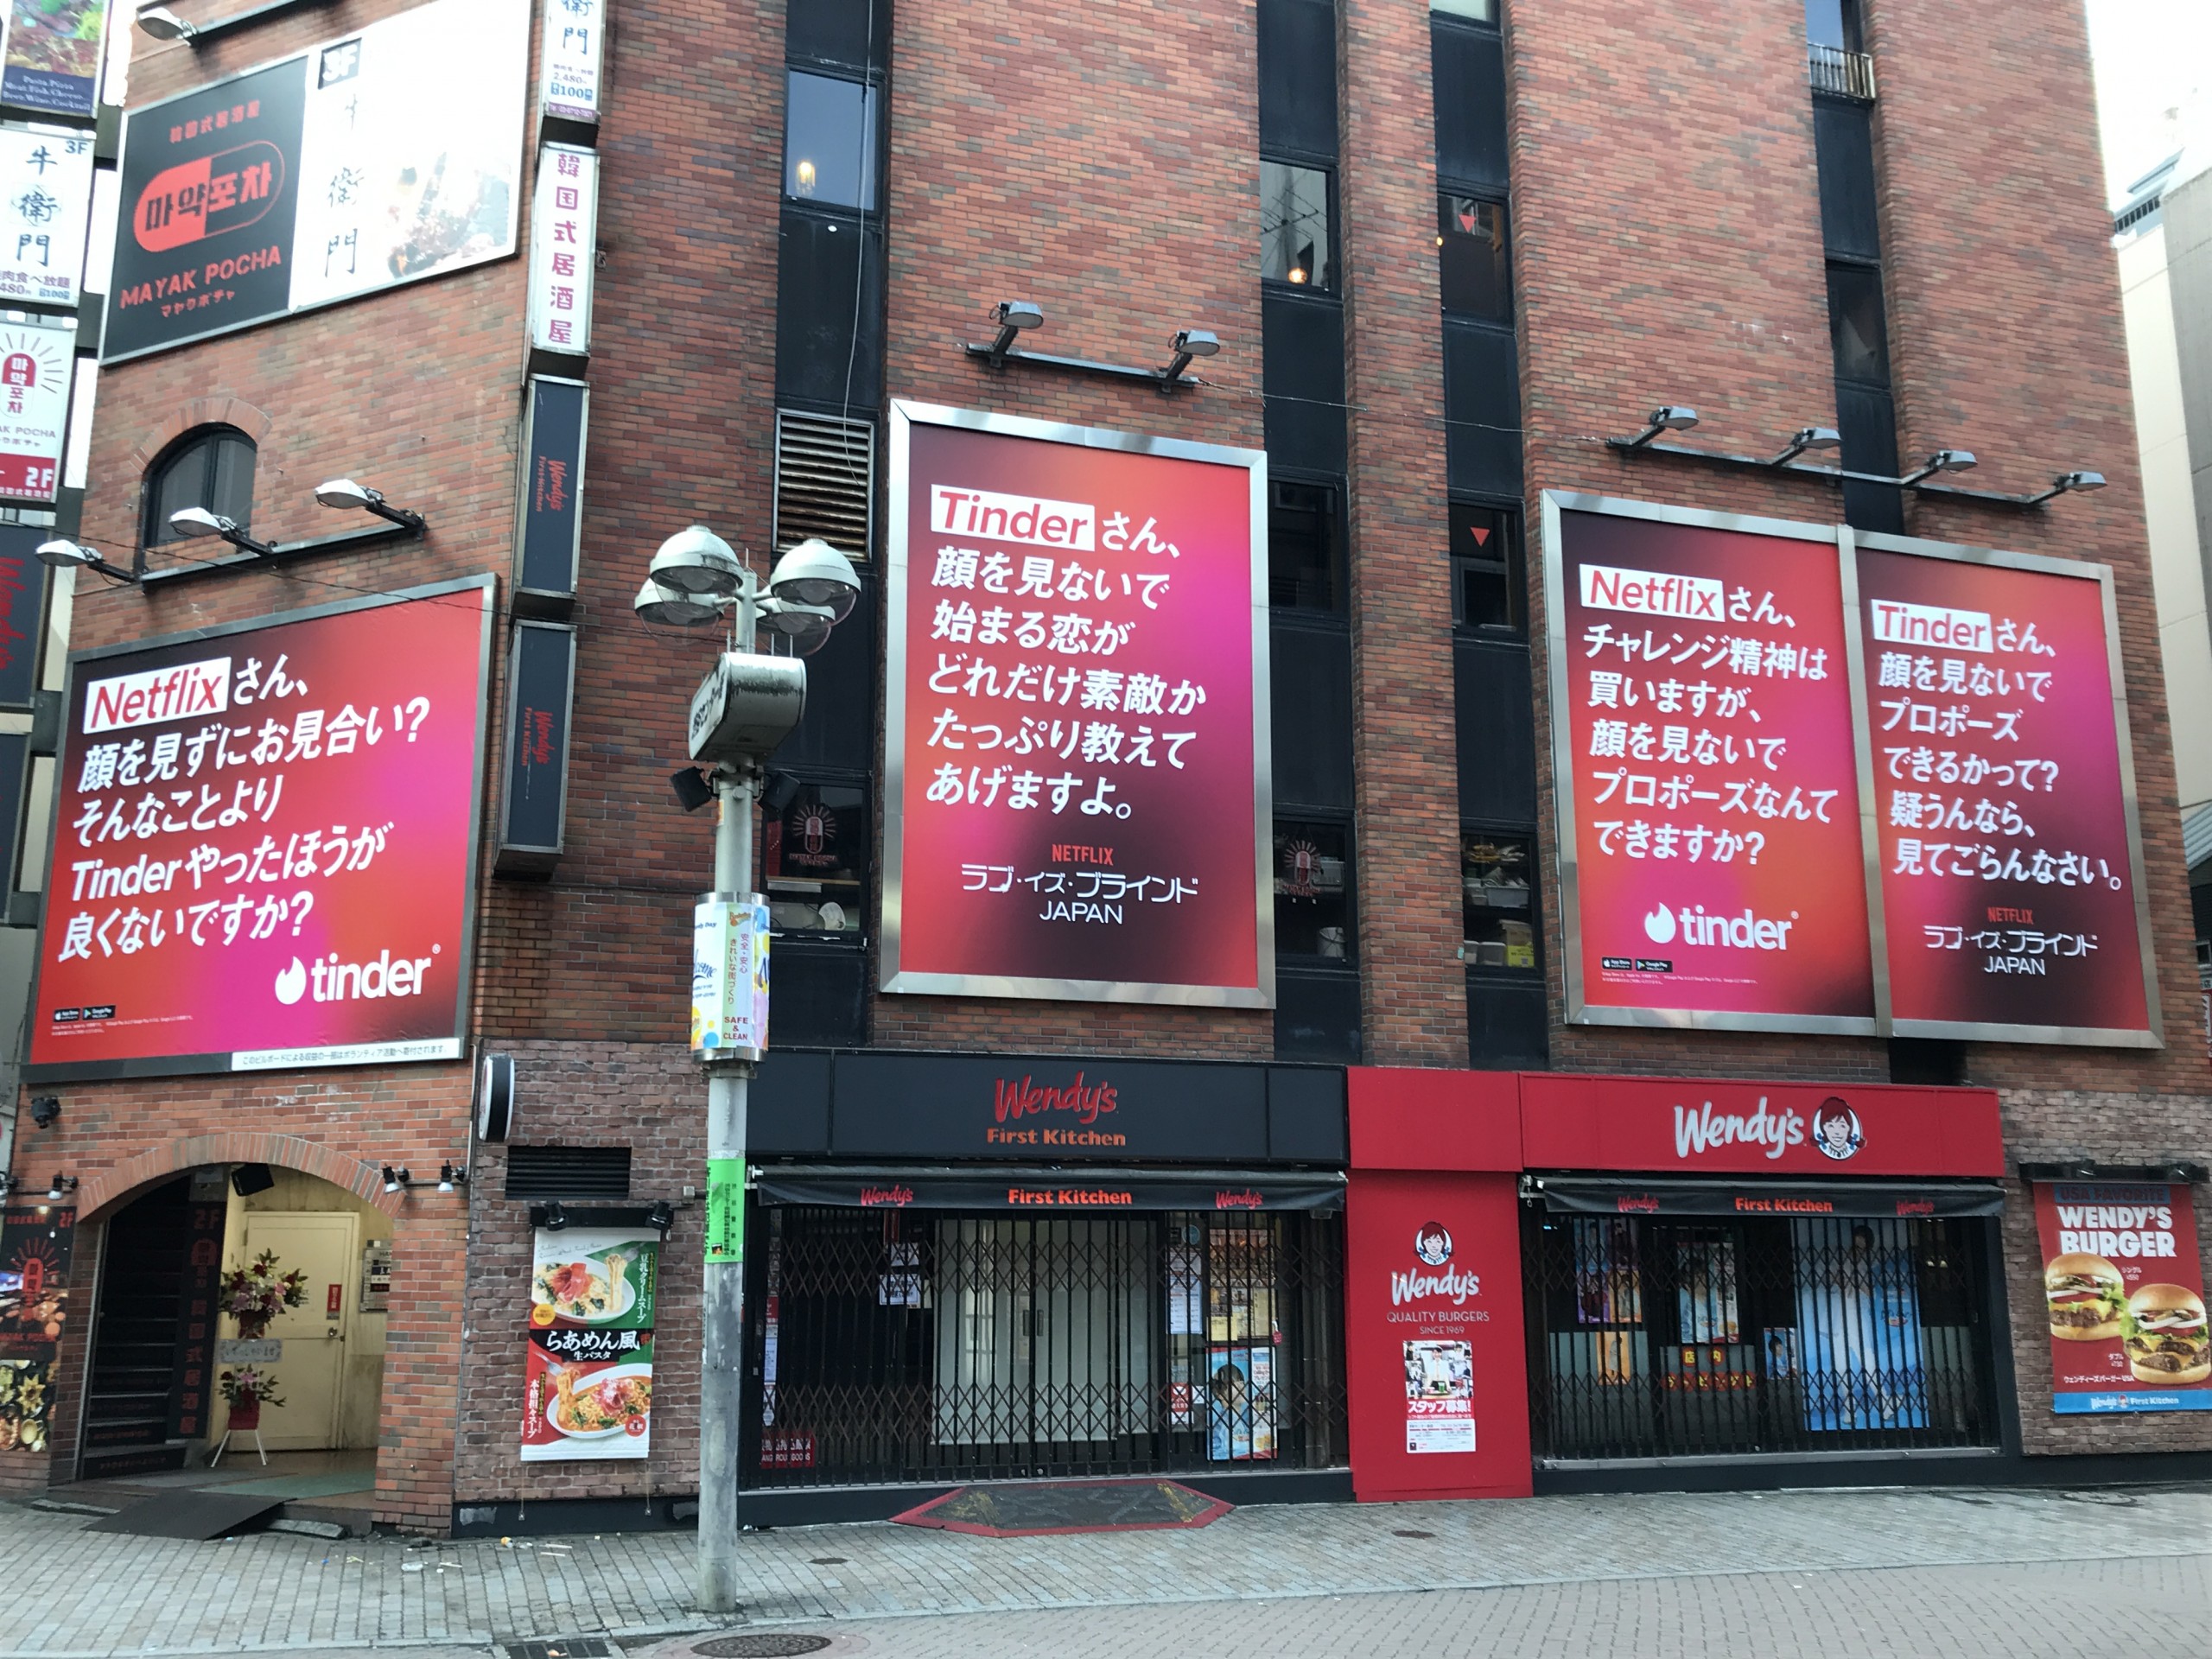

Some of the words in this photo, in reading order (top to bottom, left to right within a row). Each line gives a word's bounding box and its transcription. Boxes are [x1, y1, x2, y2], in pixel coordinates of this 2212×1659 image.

[65, 140, 88, 155] 3F
[16, 145, 58, 268] 牛衛門
[145, 161, 272, 232] 마약포차
[548, 153, 581, 346] 韓国式居酒屋
[119, 270, 198, 309] MAYAK
[205, 245, 282, 285] POCHA
[25, 466, 54, 488] 2F
[546, 459, 569, 512] Wendy's
[931, 545, 1171, 610] 顔を見ないで
[931, 598, 1137, 657] 始まる恋が
[1583, 623, 1828, 681] チャレンジ精神は
[928, 652, 1207, 716] どれだけ素敵か
[1587, 670, 1762, 723] 買いますが、
[1878, 651, 2053, 703] 顔を見ないで
[532, 710, 555, 765] Wendy's
[927, 707, 1197, 770] たっぷり教えて
[1880, 696, 2024, 742] プロポーズ
[1589, 718, 1787, 772] 顔を見ないで
[73, 774, 285, 848] そんなことより
[926, 762, 1132, 820] あげますよ。
[1592, 766, 1839, 823] プロポーズなんて
[1890, 790, 2036, 838] 疑うんなら、
[70, 821, 395, 902] Tinderやったほうが
[1052, 843, 1115, 866] NETFLIX
[1893, 837, 2122, 891] 見てごらんなさい。
[1039, 900, 1123, 925] JAPAN
[1679, 904, 1793, 951] tinder
[1987, 907, 2035, 925] NETFLIX
[310, 948, 433, 1003] tinder
[1983, 956, 2047, 976] JAPAN
[723, 1032, 748, 1040] CLEAN
[995, 1071, 1118, 1124] Wendy's
[987, 1128, 1038, 1145] First
[1043, 1128, 1127, 1147] Kitchen
[1674, 1096, 1805, 1160] Wendy's
[861, 1185, 914, 1206] Wendy's
[1008, 1189, 1054, 1205] First
[1058, 1189, 1133, 1205] Kitchen
[1216, 1187, 1263, 1209] Wendy's
[1618, 1194, 1660, 1215] Wendy's
[1735, 1198, 1772, 1211] First
[1774, 1198, 1834, 1213] Kitchen
[2057, 1205, 2173, 1230] WENDY'S
[2060, 1187, 2090, 1200] USA
[2094, 1187, 2164, 1201] FAVORITE
[2059, 1230, 2178, 1258] BURGER
[1390, 1263, 1481, 1306] Wendy's
[546, 1330, 640, 1351] らあめん風
[1387, 1312, 1436, 1323] QUALITY
[1438, 1312, 1490, 1323] BURGERS
[1420, 1326, 1444, 1335] SINCE
[1446, 1326, 1465, 1335] 1969
[574, 1350, 613, 1362] 生パスタ
